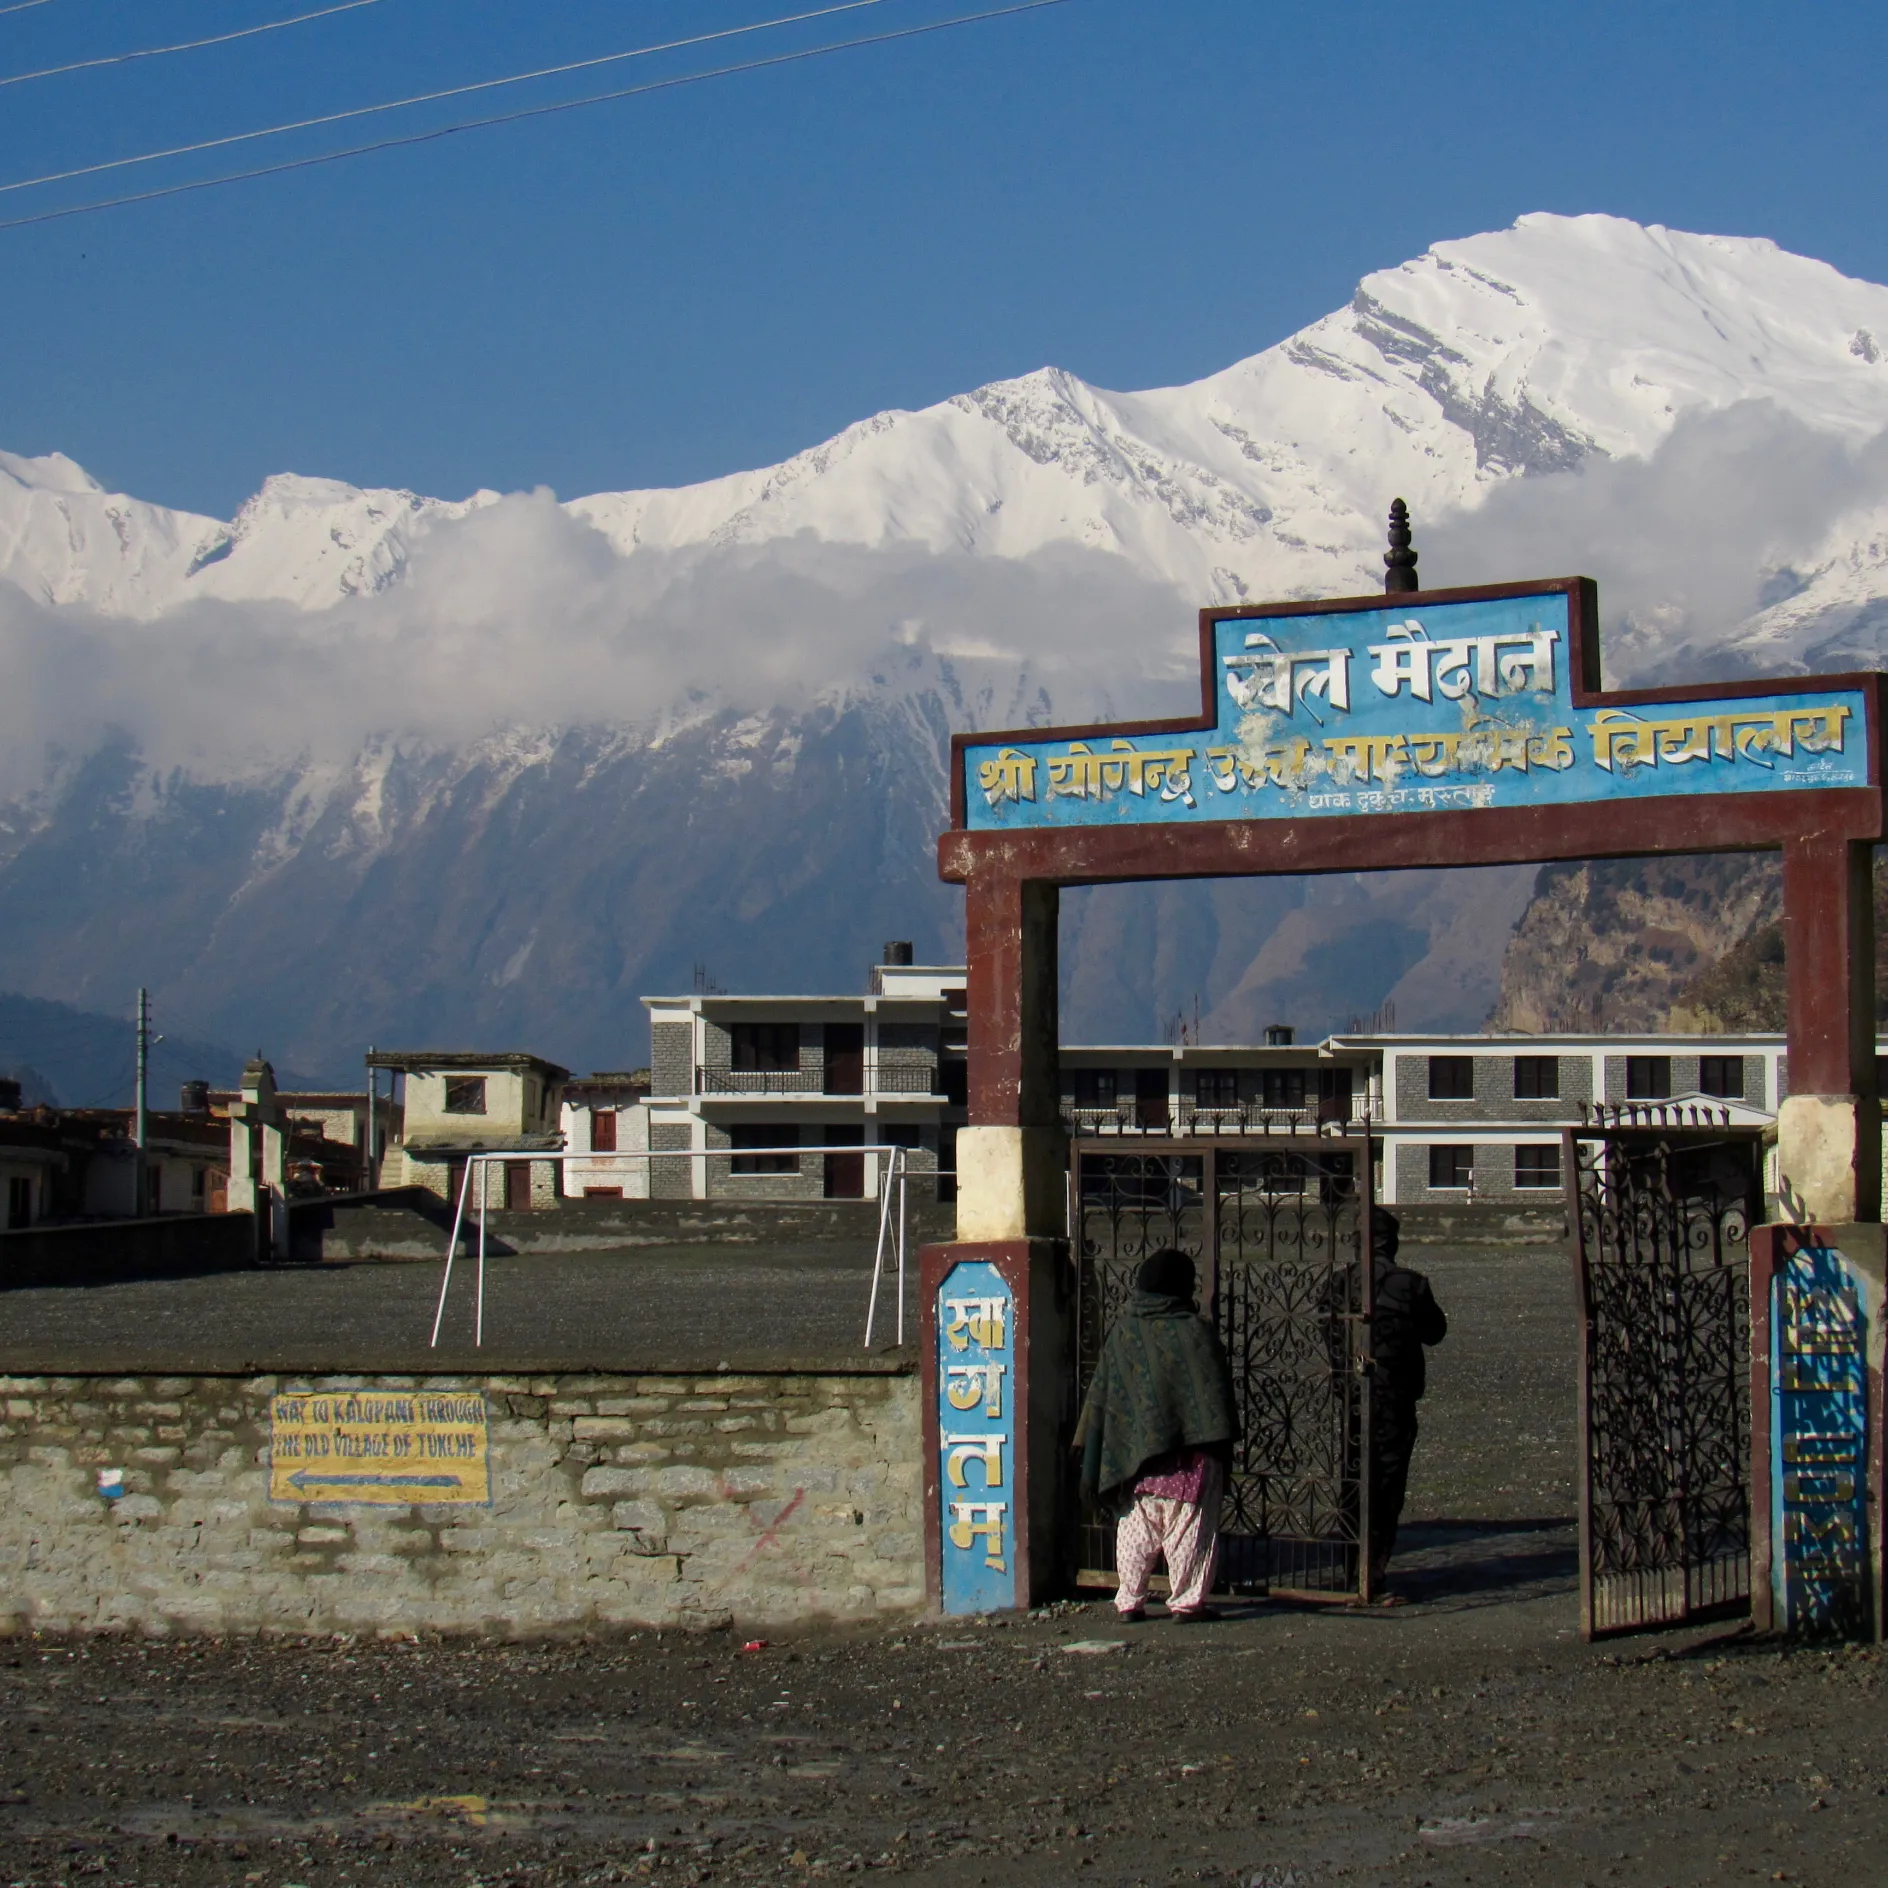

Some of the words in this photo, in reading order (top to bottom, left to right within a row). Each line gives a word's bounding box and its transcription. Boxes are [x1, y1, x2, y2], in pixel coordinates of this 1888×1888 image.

[1222, 633, 1354, 727] खेल
[1366, 619, 1562, 705] मैदान
[979, 748, 1038, 806] श्री
[1046, 740, 1197, 809] योगेन्द्र
[1585, 709, 1852, 774] विद्यालय
[275, 1400, 305, 1423] WAY
[312, 1400, 329, 1423] TO
[333, 1400, 415, 1424] KALOPANI
[418, 1400, 485, 1424] THROUGH
[274, 1433, 301, 1457] THE
[304, 1433, 330, 1457] OLD
[333, 1433, 388, 1457] VILLAGE
[392, 1433, 412, 1457] OF
[416, 1433, 476, 1458] TUKCHE
